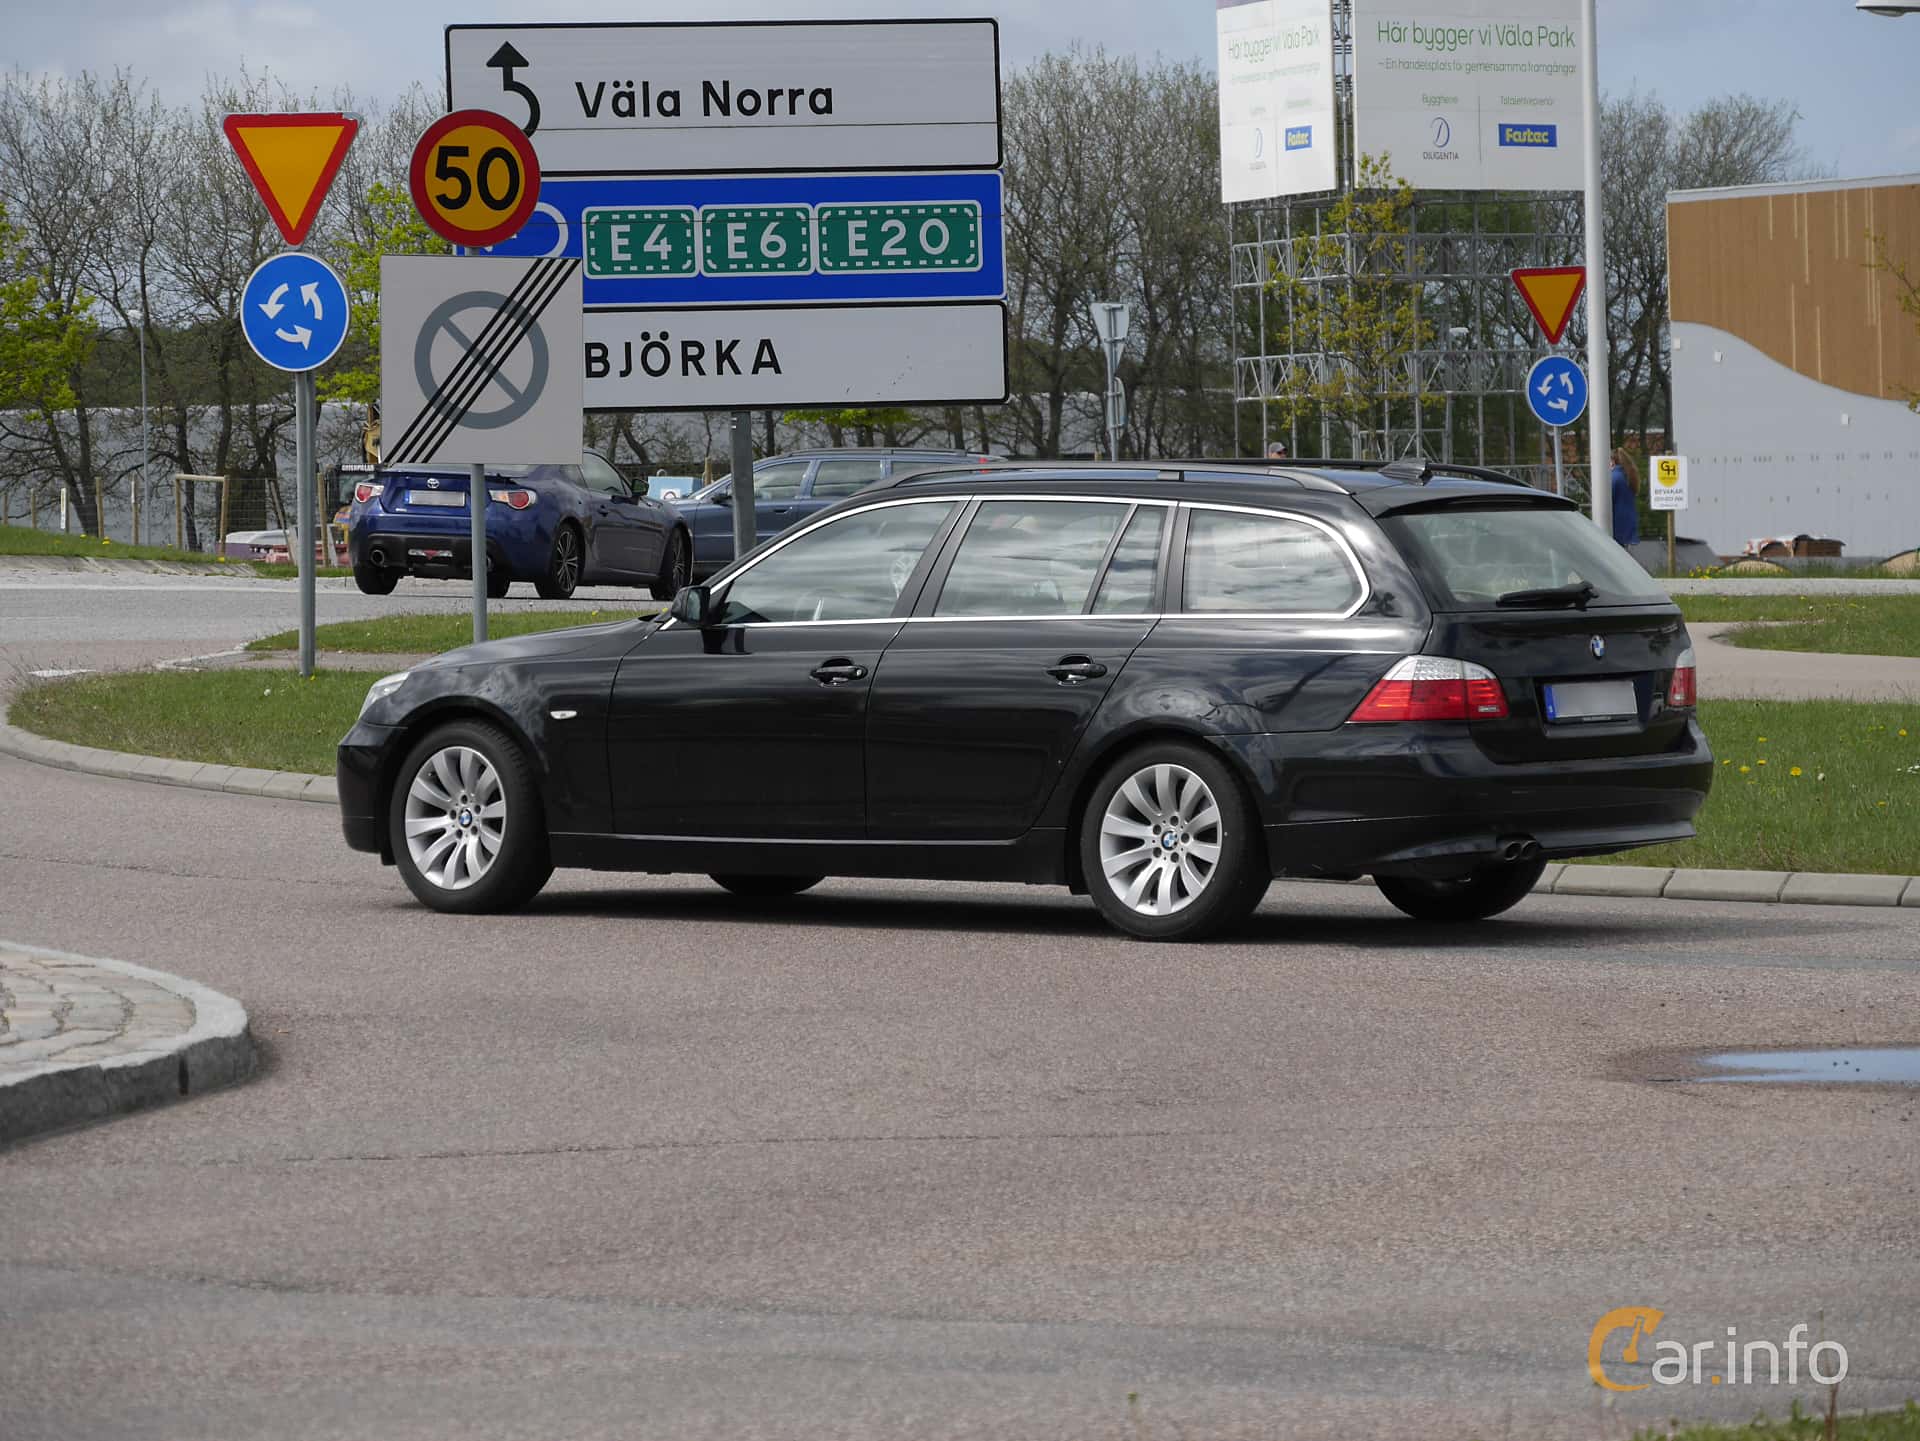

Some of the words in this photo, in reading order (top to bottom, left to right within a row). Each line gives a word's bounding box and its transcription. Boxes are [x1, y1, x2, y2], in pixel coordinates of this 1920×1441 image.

[1377, 20, 1408, 43] Här
[1413, 20, 1475, 51] bygger
[1478, 24, 1492, 47] vi
[1495, 24, 1533, 47] Väla
[1537, 25, 1577, 48] Park
[575, 79, 682, 119] Väla
[702, 79, 833, 117] Norra
[434, 145, 521, 211] 50
[584, 332, 782, 380] BJÖRKA
